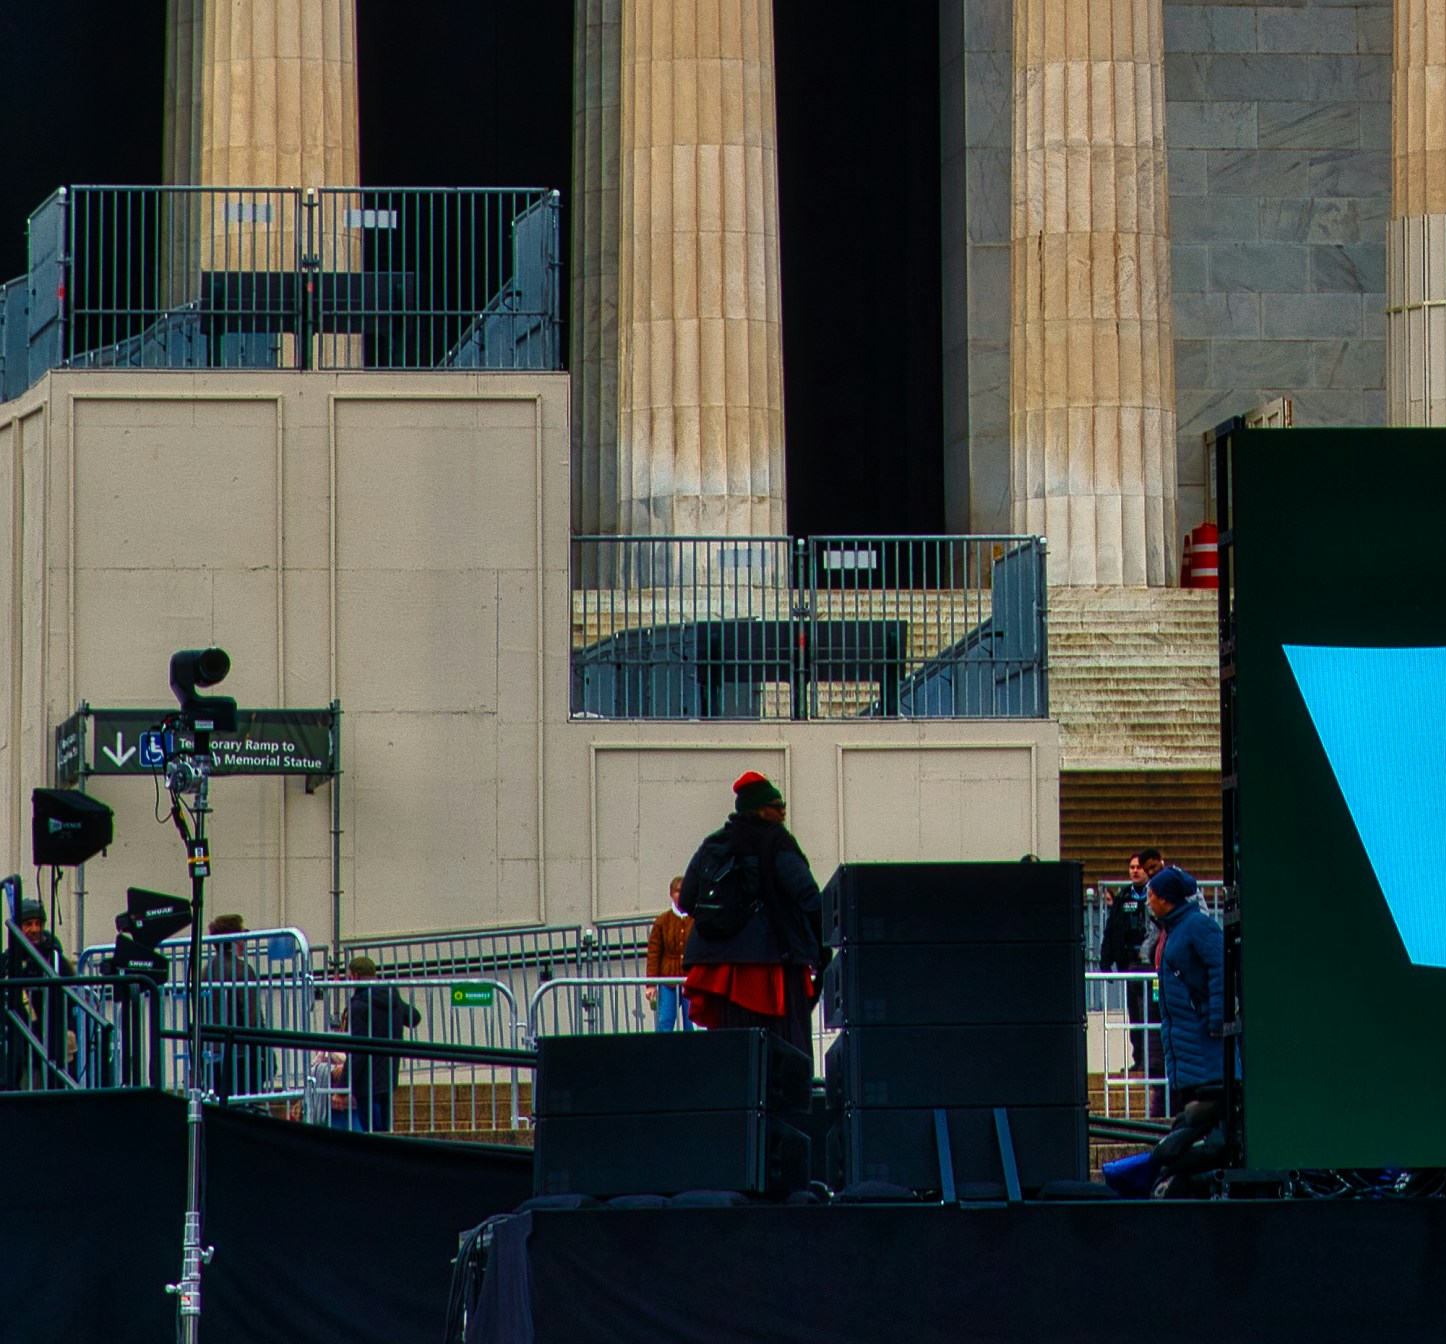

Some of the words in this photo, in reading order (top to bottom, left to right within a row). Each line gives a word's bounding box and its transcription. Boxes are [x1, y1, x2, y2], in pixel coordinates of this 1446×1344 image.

[179, 738, 242, 753] Teorary
[245, 739, 279, 753] Ramp
[282, 741, 295, 753] to
[225, 754, 280, 767] Memorial
[283, 756, 322, 769] Statue
